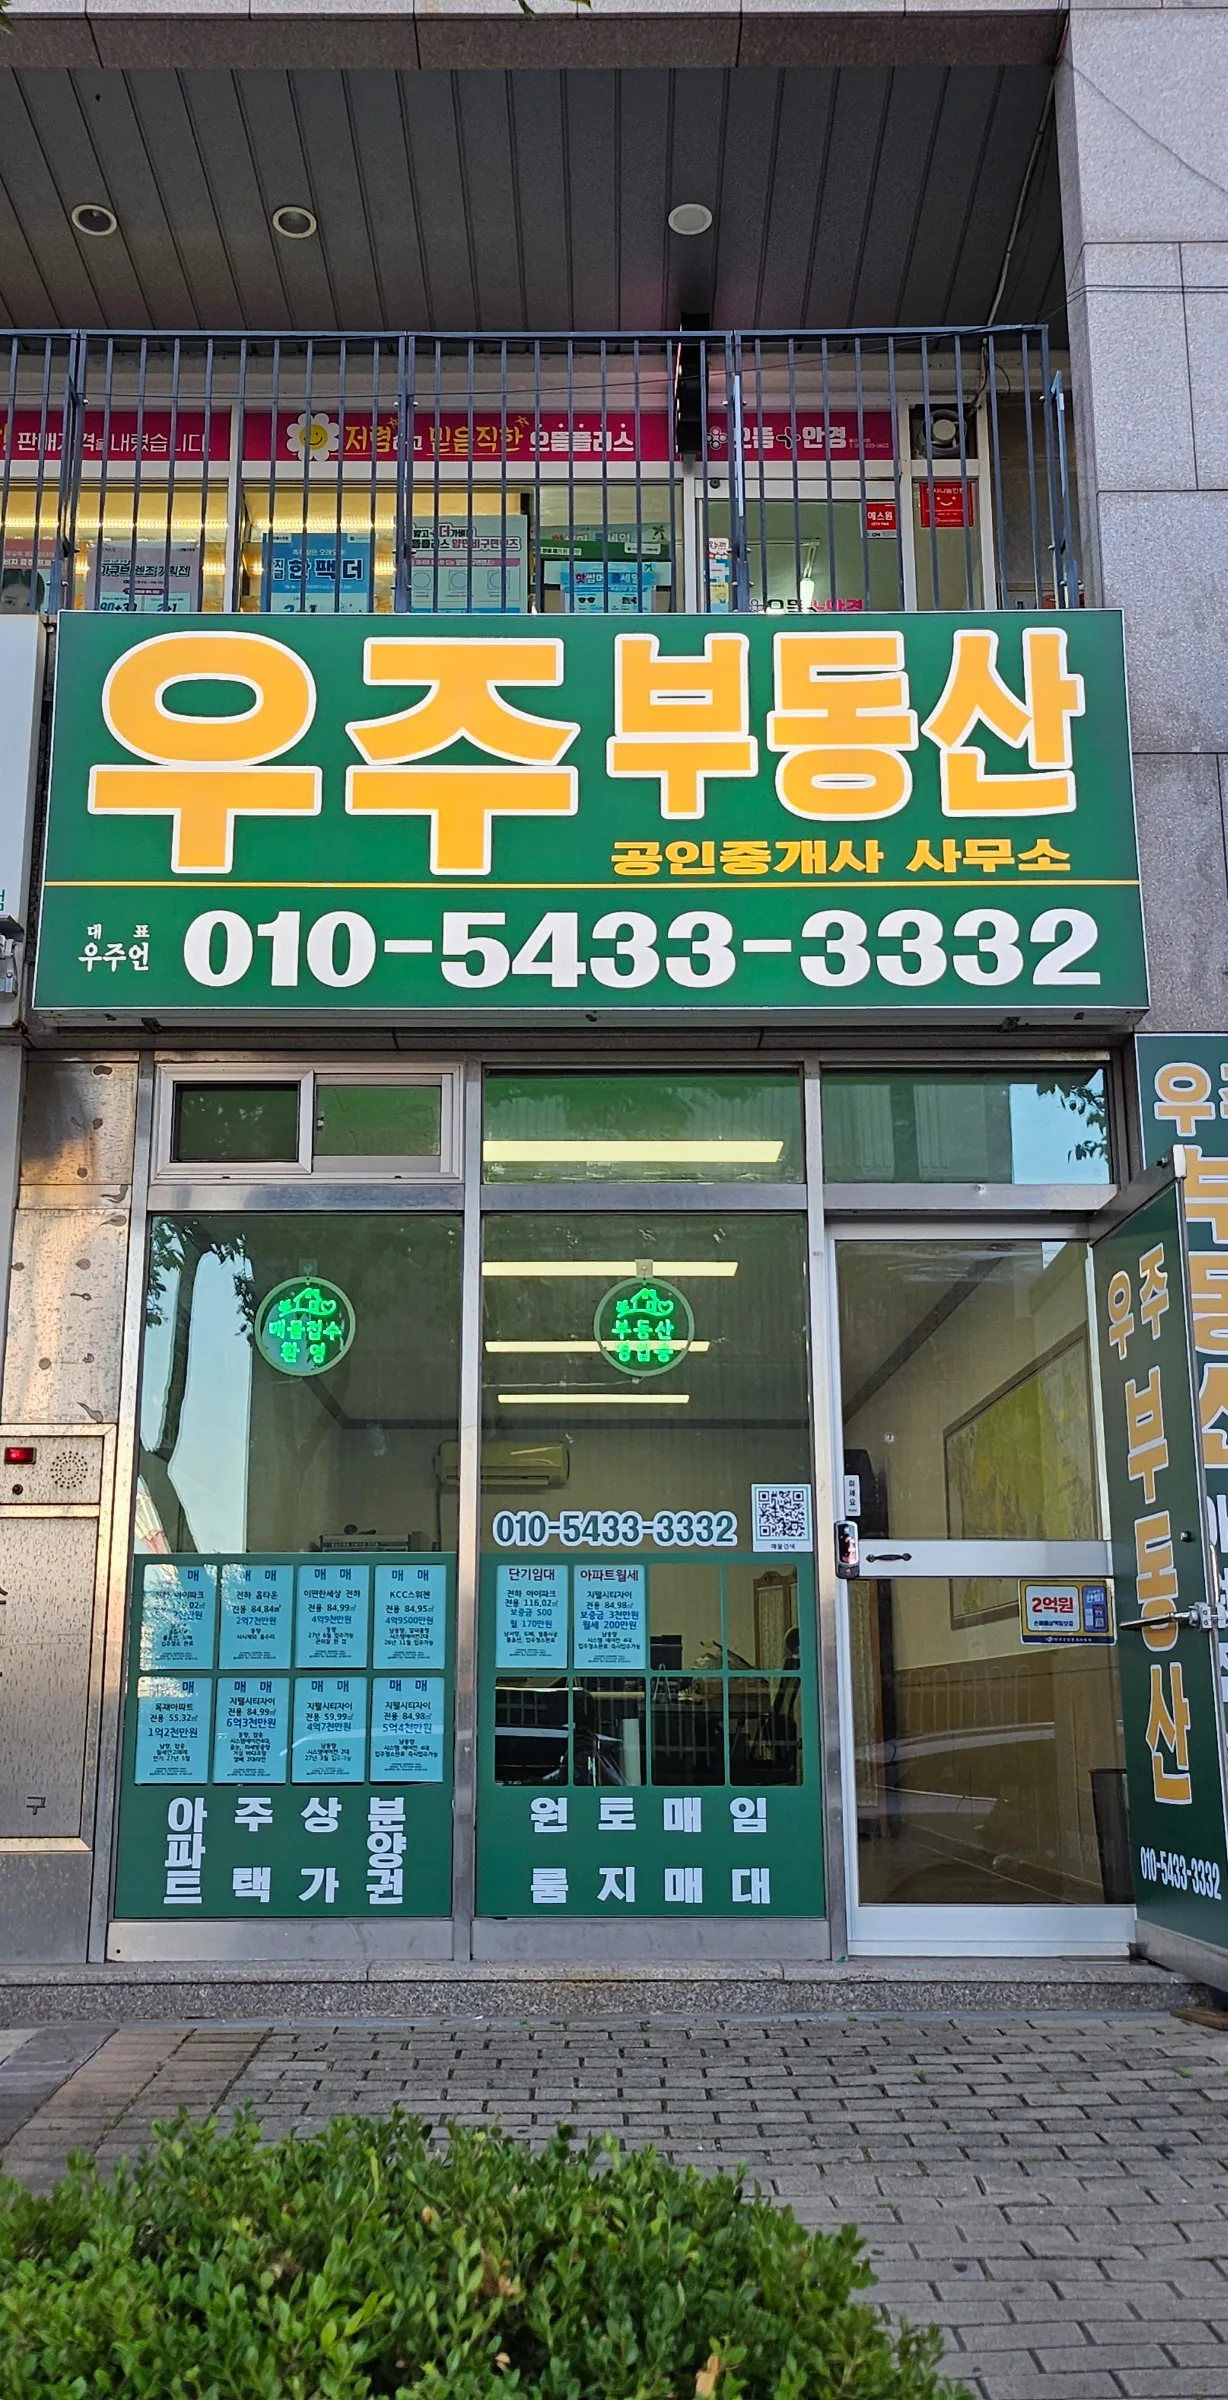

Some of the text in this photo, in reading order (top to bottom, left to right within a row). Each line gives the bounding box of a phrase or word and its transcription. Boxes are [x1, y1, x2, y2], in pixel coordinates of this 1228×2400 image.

[87, 627, 1086, 876] 우주 부동산
[610, 838, 1072, 876] 공인중개사 사무소
[183, 909, 1101, 989] 010-5433-3332
[77, 942, 150, 973] 우주언
[1108, 1243, 1170, 1361] 우주
[611, 1319, 674, 1340] 부동산
[493, 1509, 738, 1547] 010-5433-3332
[508, 1568, 555, 1581] 단기임대
[580, 1569, 639, 1582] 아파트월세
[1125, 1365, 1192, 1805] 부동산
[303, 1590, 341, 1599] 이편한세상
[389, 1590, 431, 1600] KCC스위첸
[526, 1589, 557, 1598] 아이파크
[1032, 1596, 1074, 1613] 2억원
[311, 1615, 352, 1625] 4억9천만원
[510, 1608, 553, 1617] 보증금 500
[580, 1610, 639, 1620] 보증금 3천만원
[236, 1616, 277, 1626] 2억7천만원
[385, 1615, 434, 1626] 4억9500만원
[522, 1619, 553, 1629] 170만원
[583, 1620, 637, 1630] 월세 200만원
[234, 1681, 272, 1693] 매 매
[389, 1679, 428, 1692] 매 매
[226, 1718, 277, 1729] 6억3천만원
[306, 1722, 352, 1732] 4억7천만원
[382, 1723, 433, 1733] 5억4천만원
[148, 1727, 198, 1738] 1억2천만원
[163, 1796, 208, 1904] 아파트
[231, 1796, 273, 1904] 주택
[298, 1796, 342, 1904] 상가
[365, 1796, 408, 1905] 분양권
[530, 1796, 569, 1904] 원룸
[597, 1796, 638, 1903] 토지
[663, 1796, 703, 1904] 매매
[729, 1796, 771, 1904] 임대
[1139, 1845, 1222, 1901] 010-5433-3332
